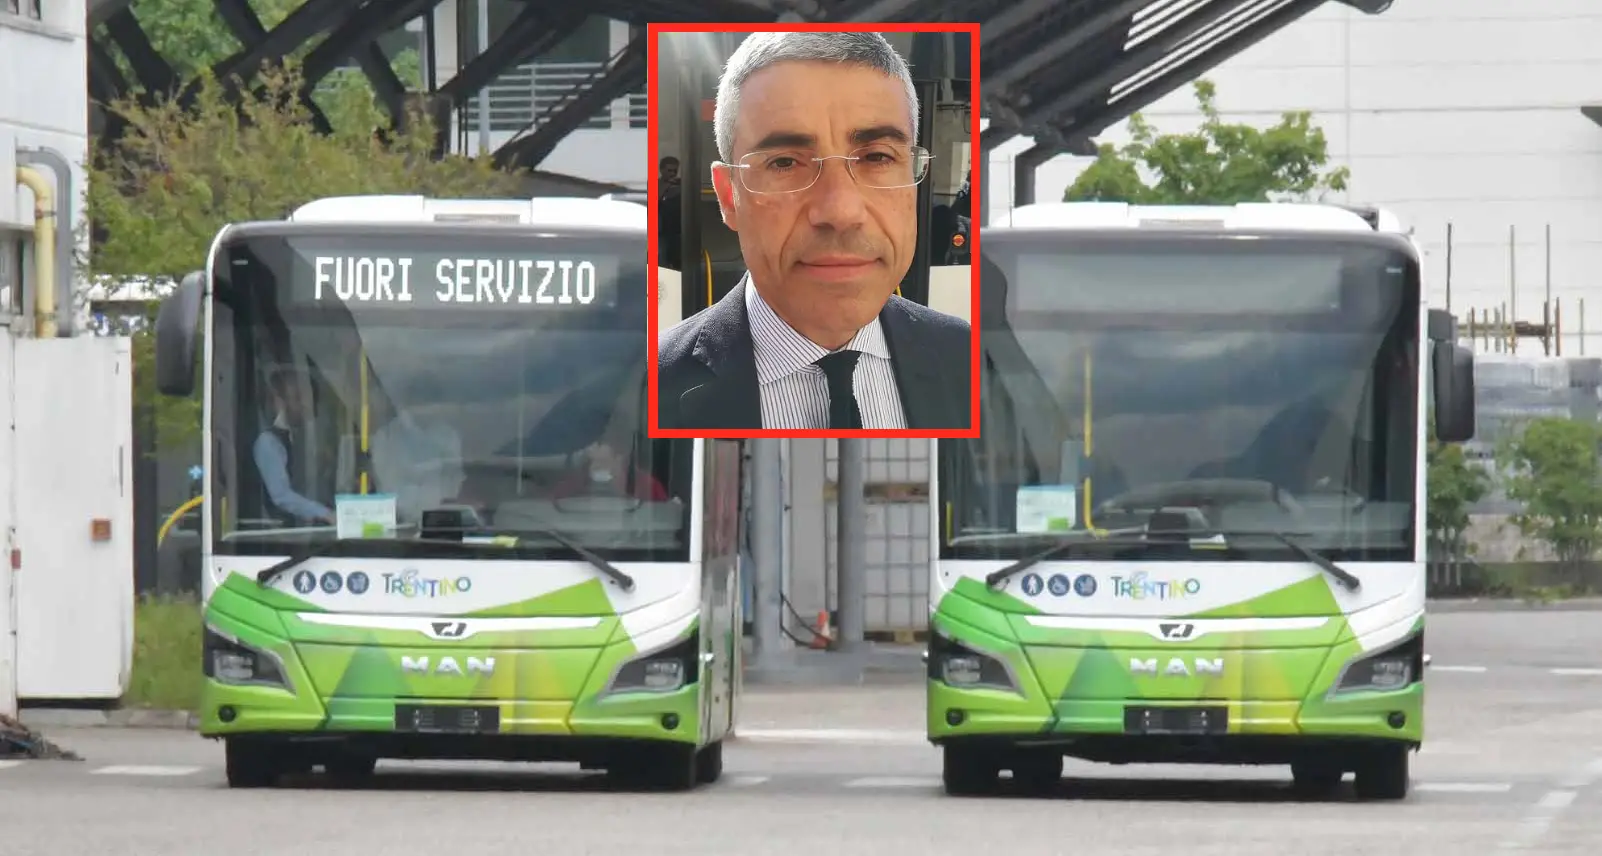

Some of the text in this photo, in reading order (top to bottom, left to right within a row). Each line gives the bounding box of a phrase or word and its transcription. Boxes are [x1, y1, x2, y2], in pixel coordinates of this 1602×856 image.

[314, 256, 595, 304] FUORI SERVIZIO
[401, 656, 496, 676] MAN
[1129, 657, 1224, 676] MAN
